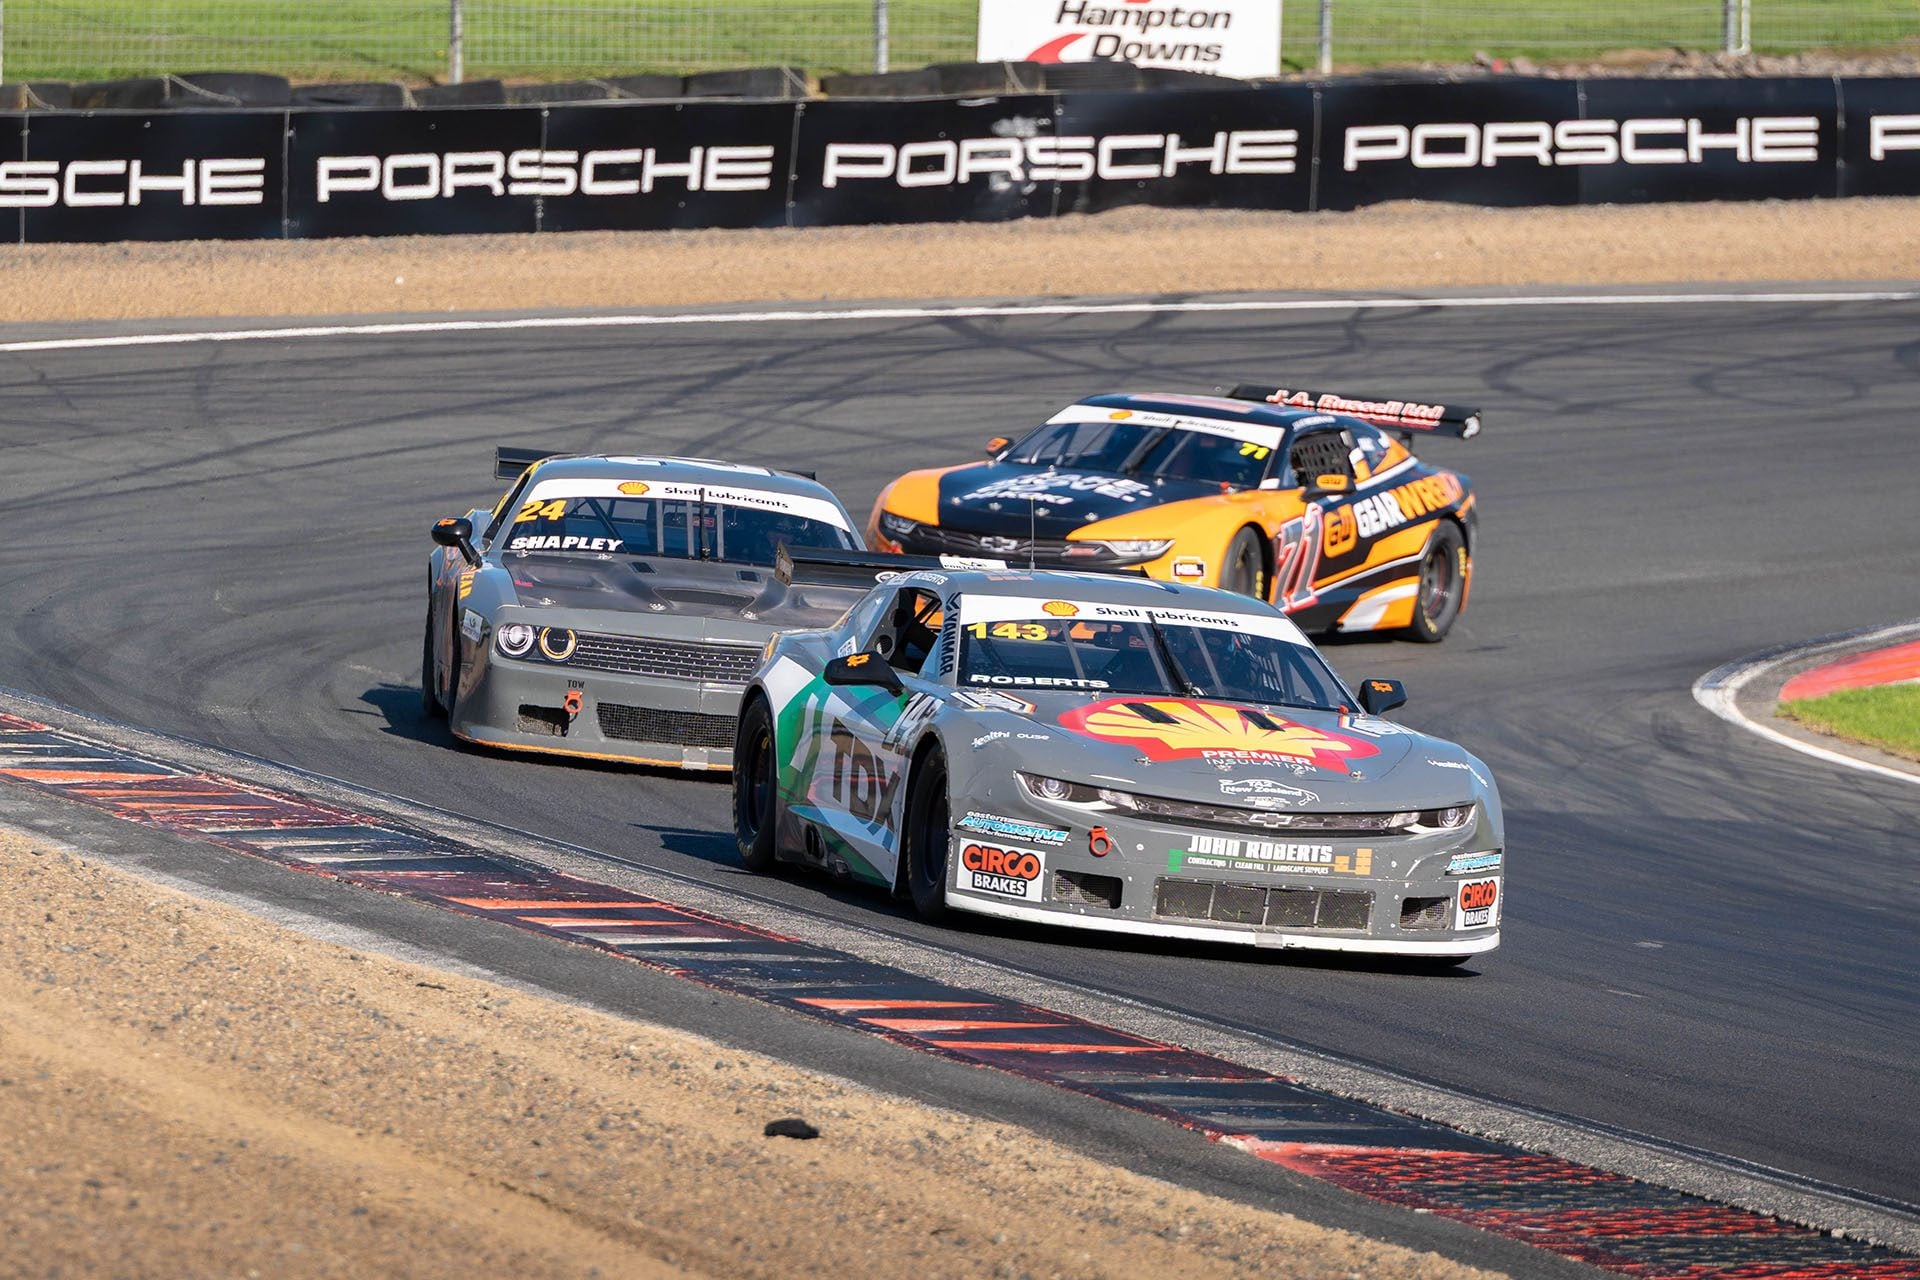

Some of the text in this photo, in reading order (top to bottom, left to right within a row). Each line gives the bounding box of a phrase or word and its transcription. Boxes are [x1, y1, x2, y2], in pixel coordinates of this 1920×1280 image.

[1056, 0, 1232, 33] Hampton
[1093, 34, 1222, 62] Downs
[1344, 117, 1819, 171] PORSCHE
[823, 130, 1297, 188] PORSCHE
[317, 145, 774, 202] PORSCHE
[1266, 390, 1445, 419] J.A. Russell Ltd
[1239, 441, 1270, 460] 71
[664, 486, 789, 508] Shell Lubricants
[514, 500, 567, 523] 24
[510, 536, 623, 552] SHAPLEY
[1276, 502, 1324, 613] 71
[1095, 607, 1140, 617] Shell
[967, 622, 1049, 641] 143
[567, 680, 585, 689] TOW
[970, 674, 1110, 689] ROBERTS
[1200, 750, 1312, 765] PREMIER
[1205, 759, 1317, 772] INSULATION
[1254, 786, 1302, 796] Zealand
[967, 811, 1008, 822] eastern
[957, 816, 1069, 842] AUTOMOTIVE
[1188, 835, 1333, 862] JOHN ROBERTS
[963, 844, 1040, 880] CIRCO
[974, 874, 1025, 895] BRAKES
[1461, 880, 1496, 911] CIRCO
[1465, 909, 1488, 925] BRAKES
